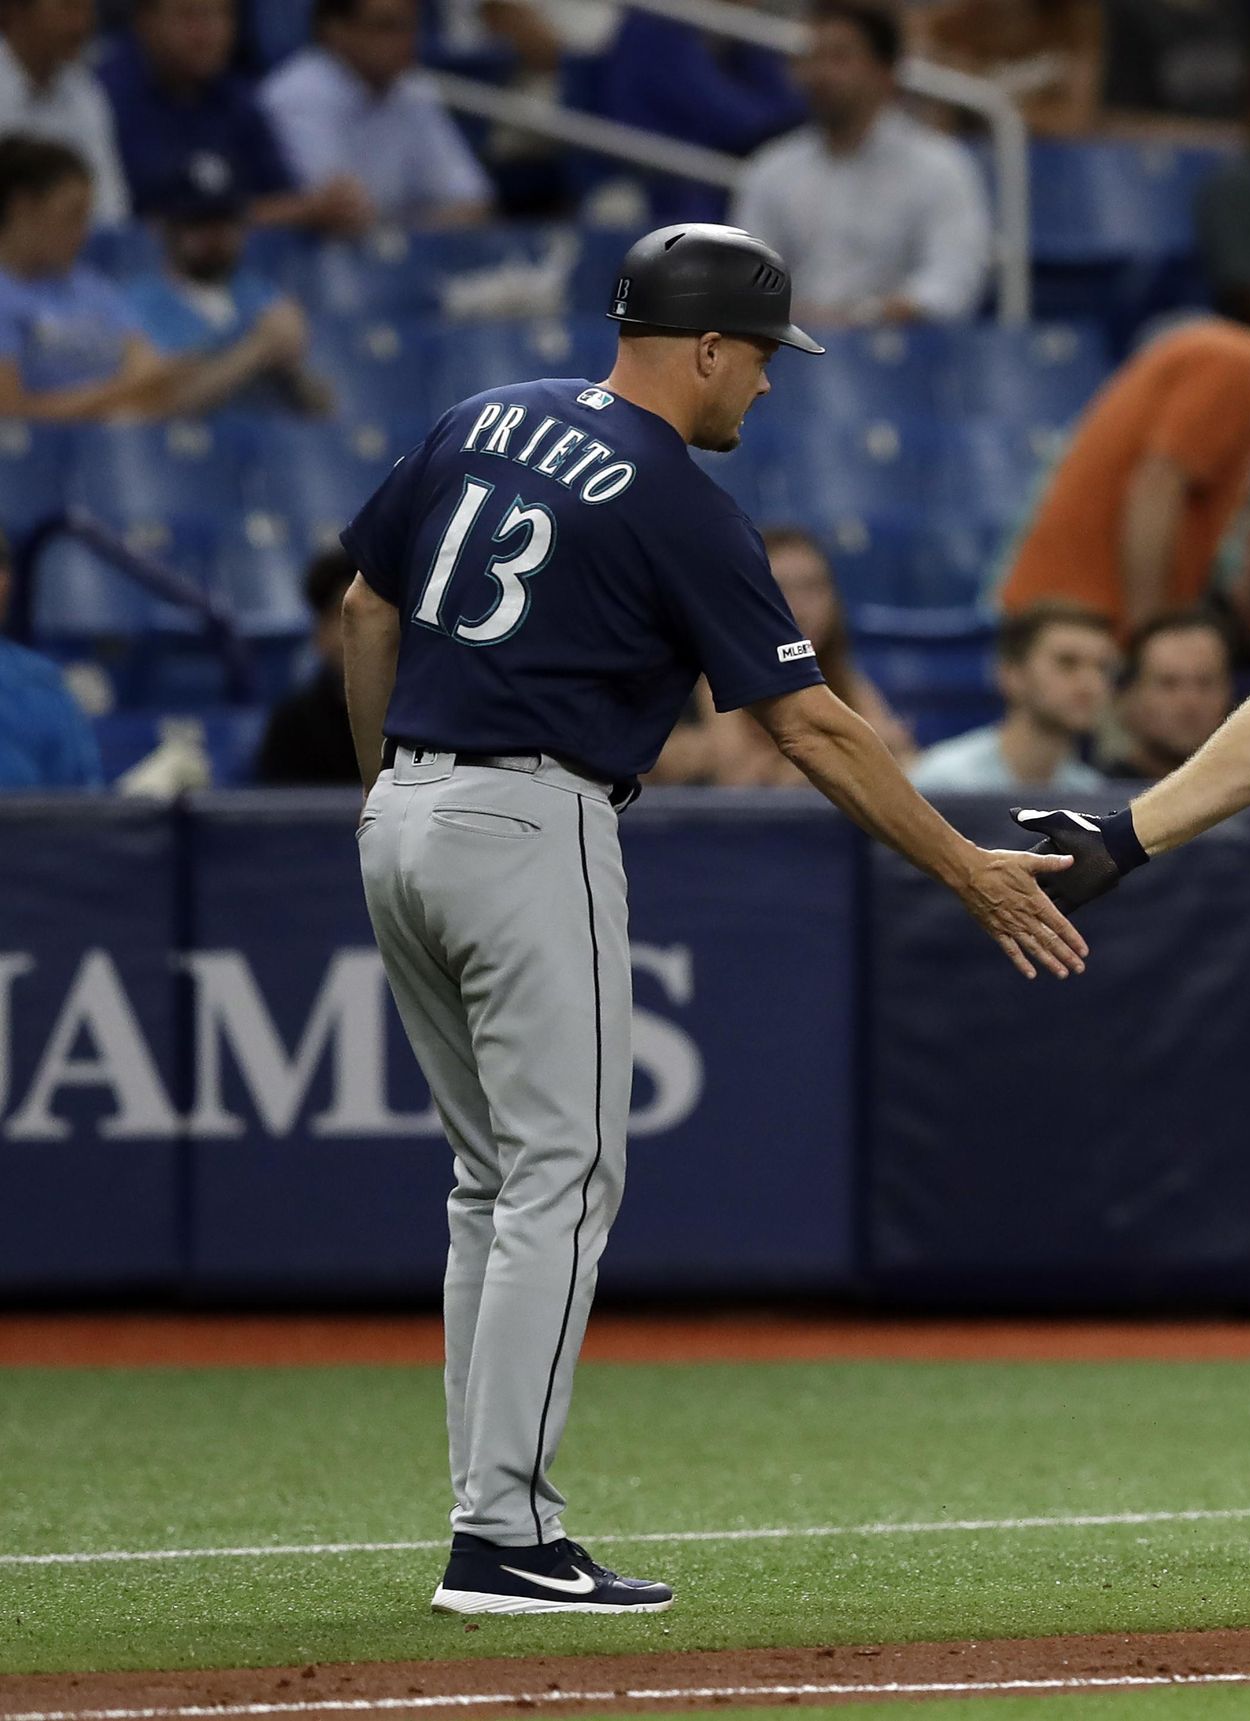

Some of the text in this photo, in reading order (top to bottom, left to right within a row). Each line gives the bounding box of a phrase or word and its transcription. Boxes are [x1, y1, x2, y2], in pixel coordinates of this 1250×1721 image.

[616, 278, 630, 299] 13
[460, 402, 637, 505] PRIETO
[411, 474, 558, 647] 13
